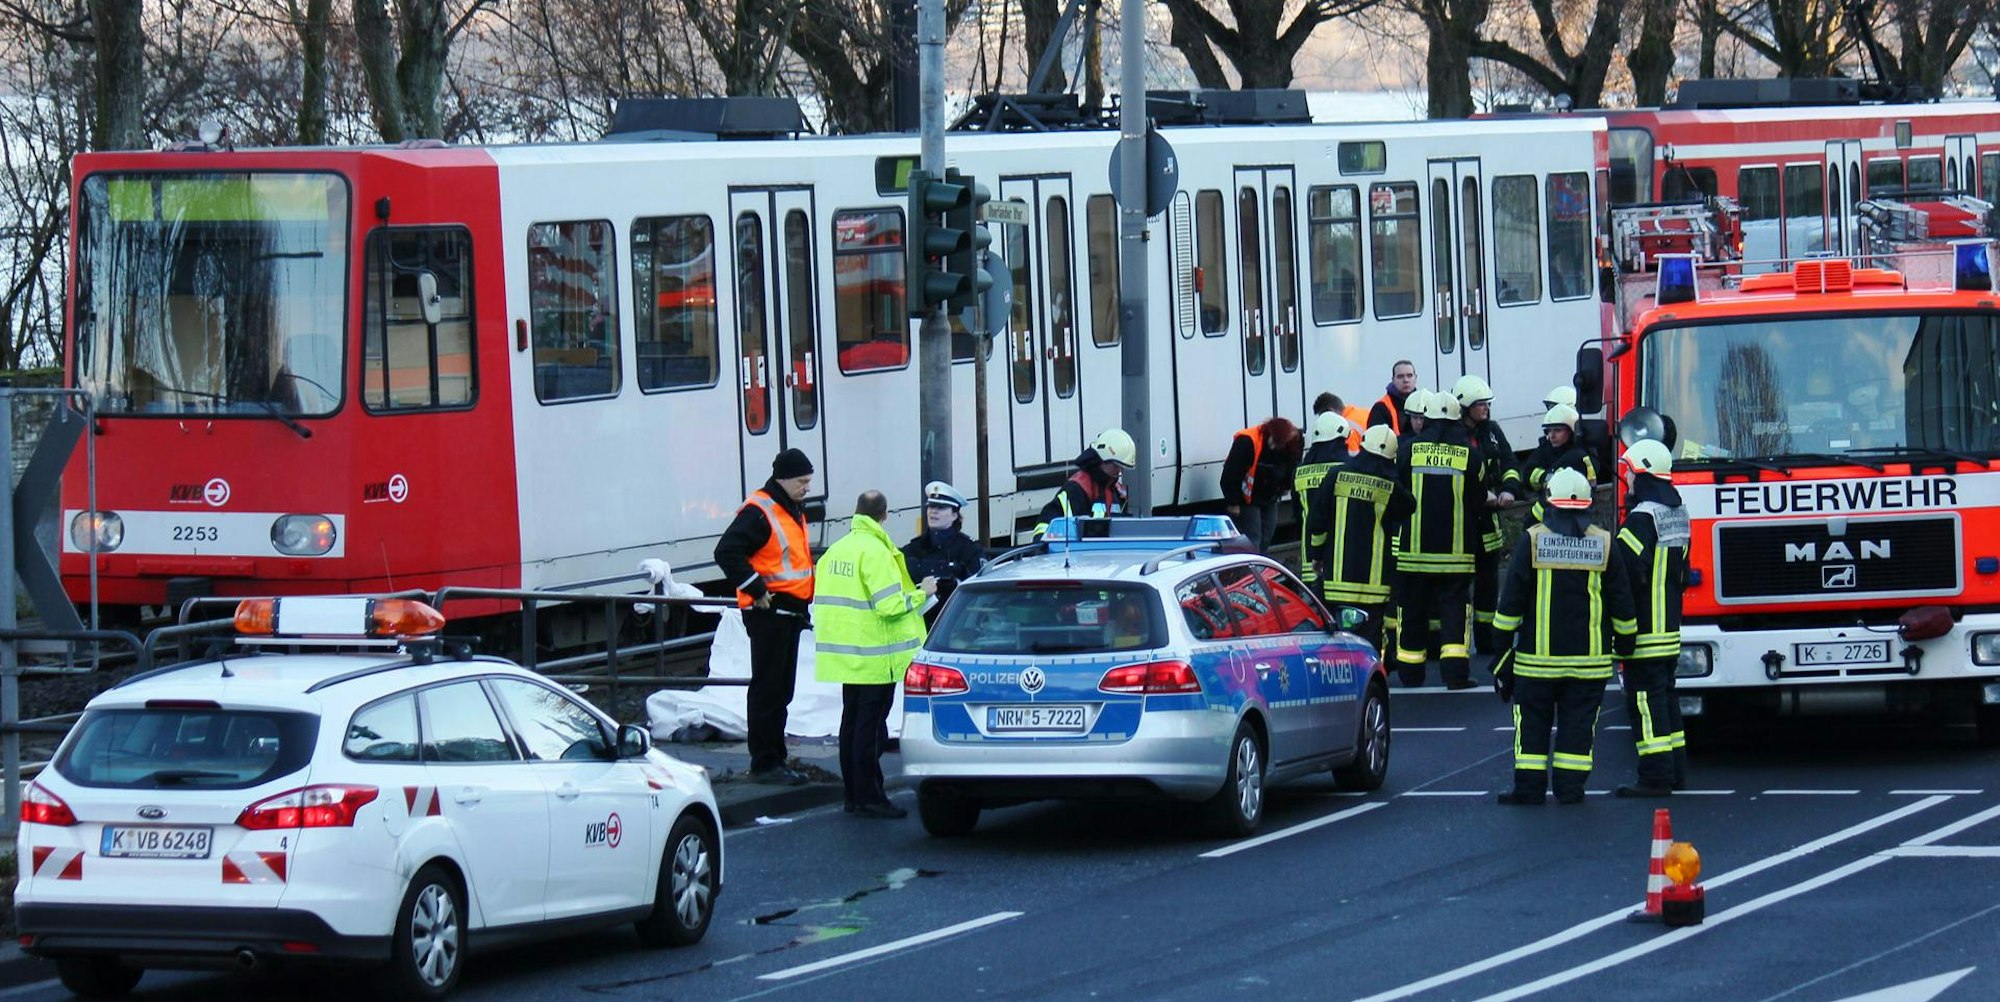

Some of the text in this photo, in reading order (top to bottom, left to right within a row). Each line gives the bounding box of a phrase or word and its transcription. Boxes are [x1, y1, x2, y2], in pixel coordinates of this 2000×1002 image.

[1413, 444, 1467, 457] BERUFSFEUERWEHR
[364, 482, 388, 500] KVB
[1339, 473, 1393, 492] BERUFSFEUERWEHR
[170, 483, 203, 501] KVB
[1350, 486, 1373, 500] KÖLN
[1715, 478, 1957, 515] FEUERWEHR
[173, 526, 218, 541] 2253
[1543, 537, 1598, 549] EINSATZLEITER
[1784, 539, 1891, 562] MAN
[1538, 548, 1602, 560] BERUFSFEUERWEHR
[828, 560, 854, 578] OLIZEI
[1804, 644, 1882, 661] K 2726
[969, 672, 1020, 684] POLIZEI
[1320, 658, 1353, 684] POLIZEI
[996, 709, 1023, 726] NRW
[112, 830, 125, 849] K
[162, 832, 207, 850] 6248
[585, 822, 606, 844] KVB
